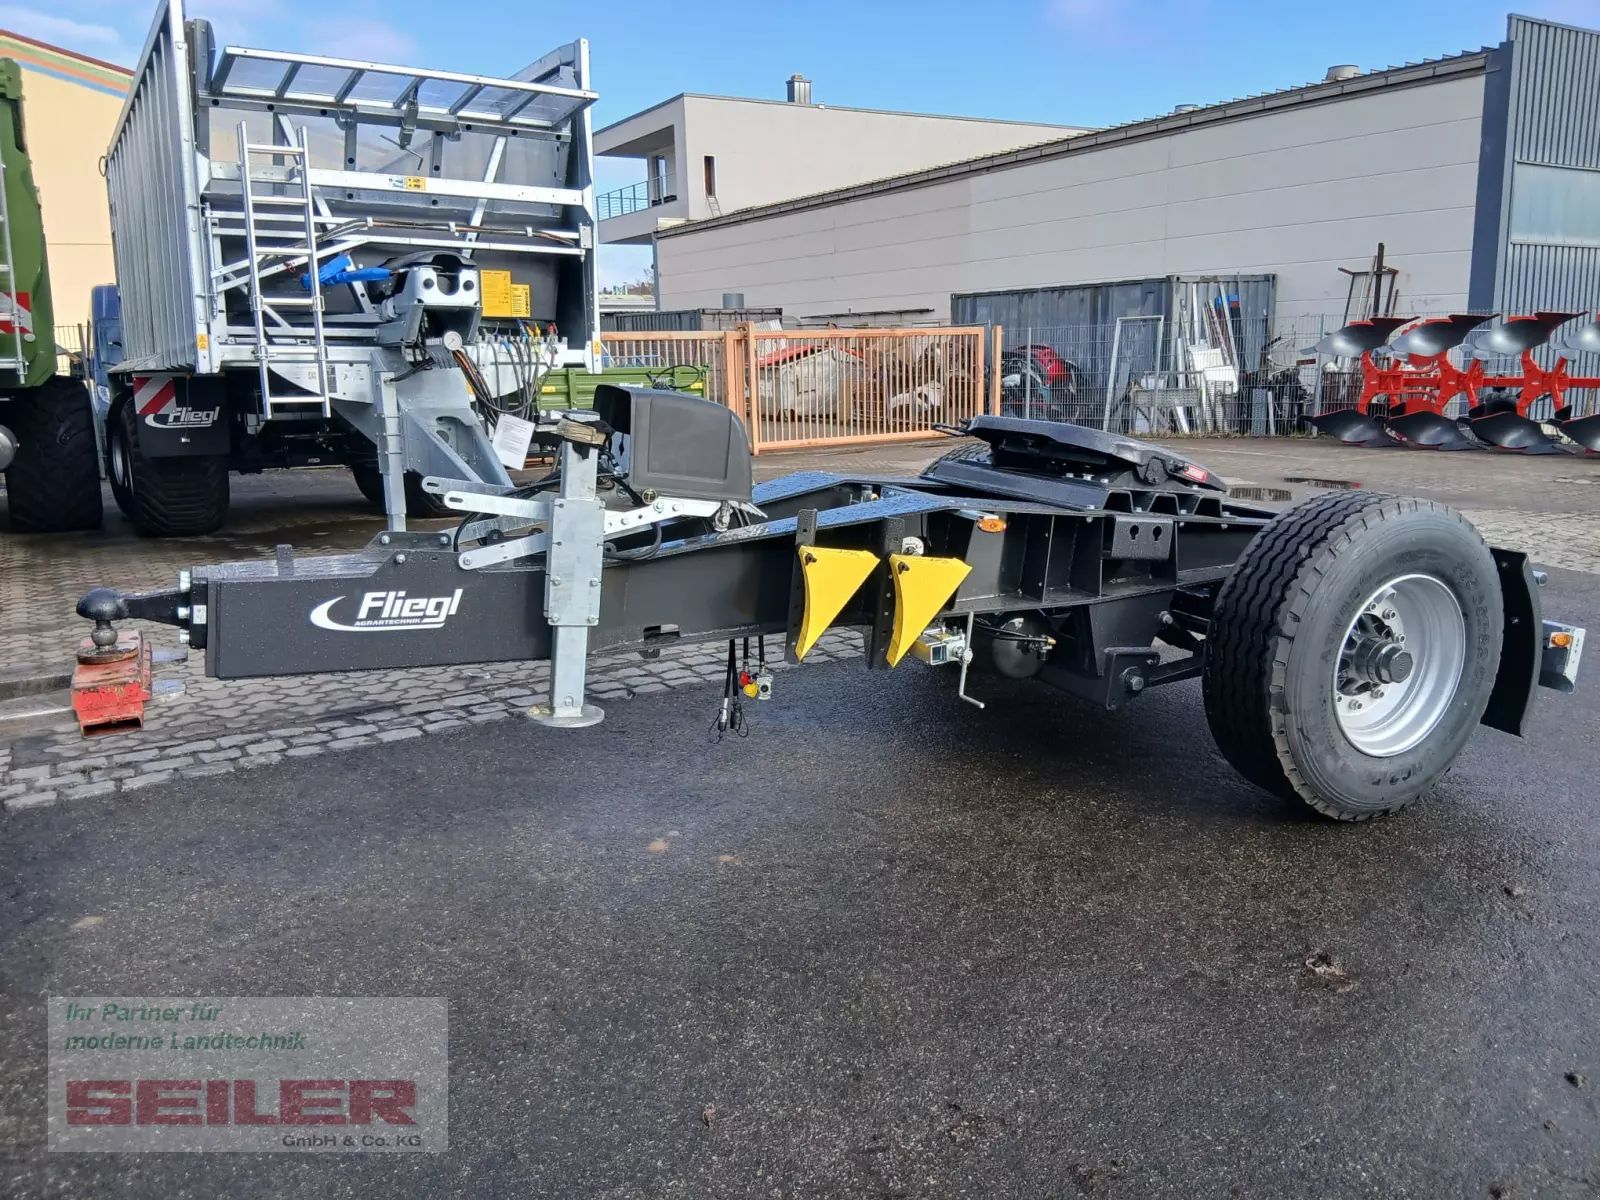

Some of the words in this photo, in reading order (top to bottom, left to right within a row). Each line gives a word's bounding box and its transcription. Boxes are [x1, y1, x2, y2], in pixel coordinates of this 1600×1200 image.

[168, 406, 220, 424] Fliegl
[357, 588, 464, 623] Fliegl
[354, 618, 422, 627] AGRARTECHNIK
